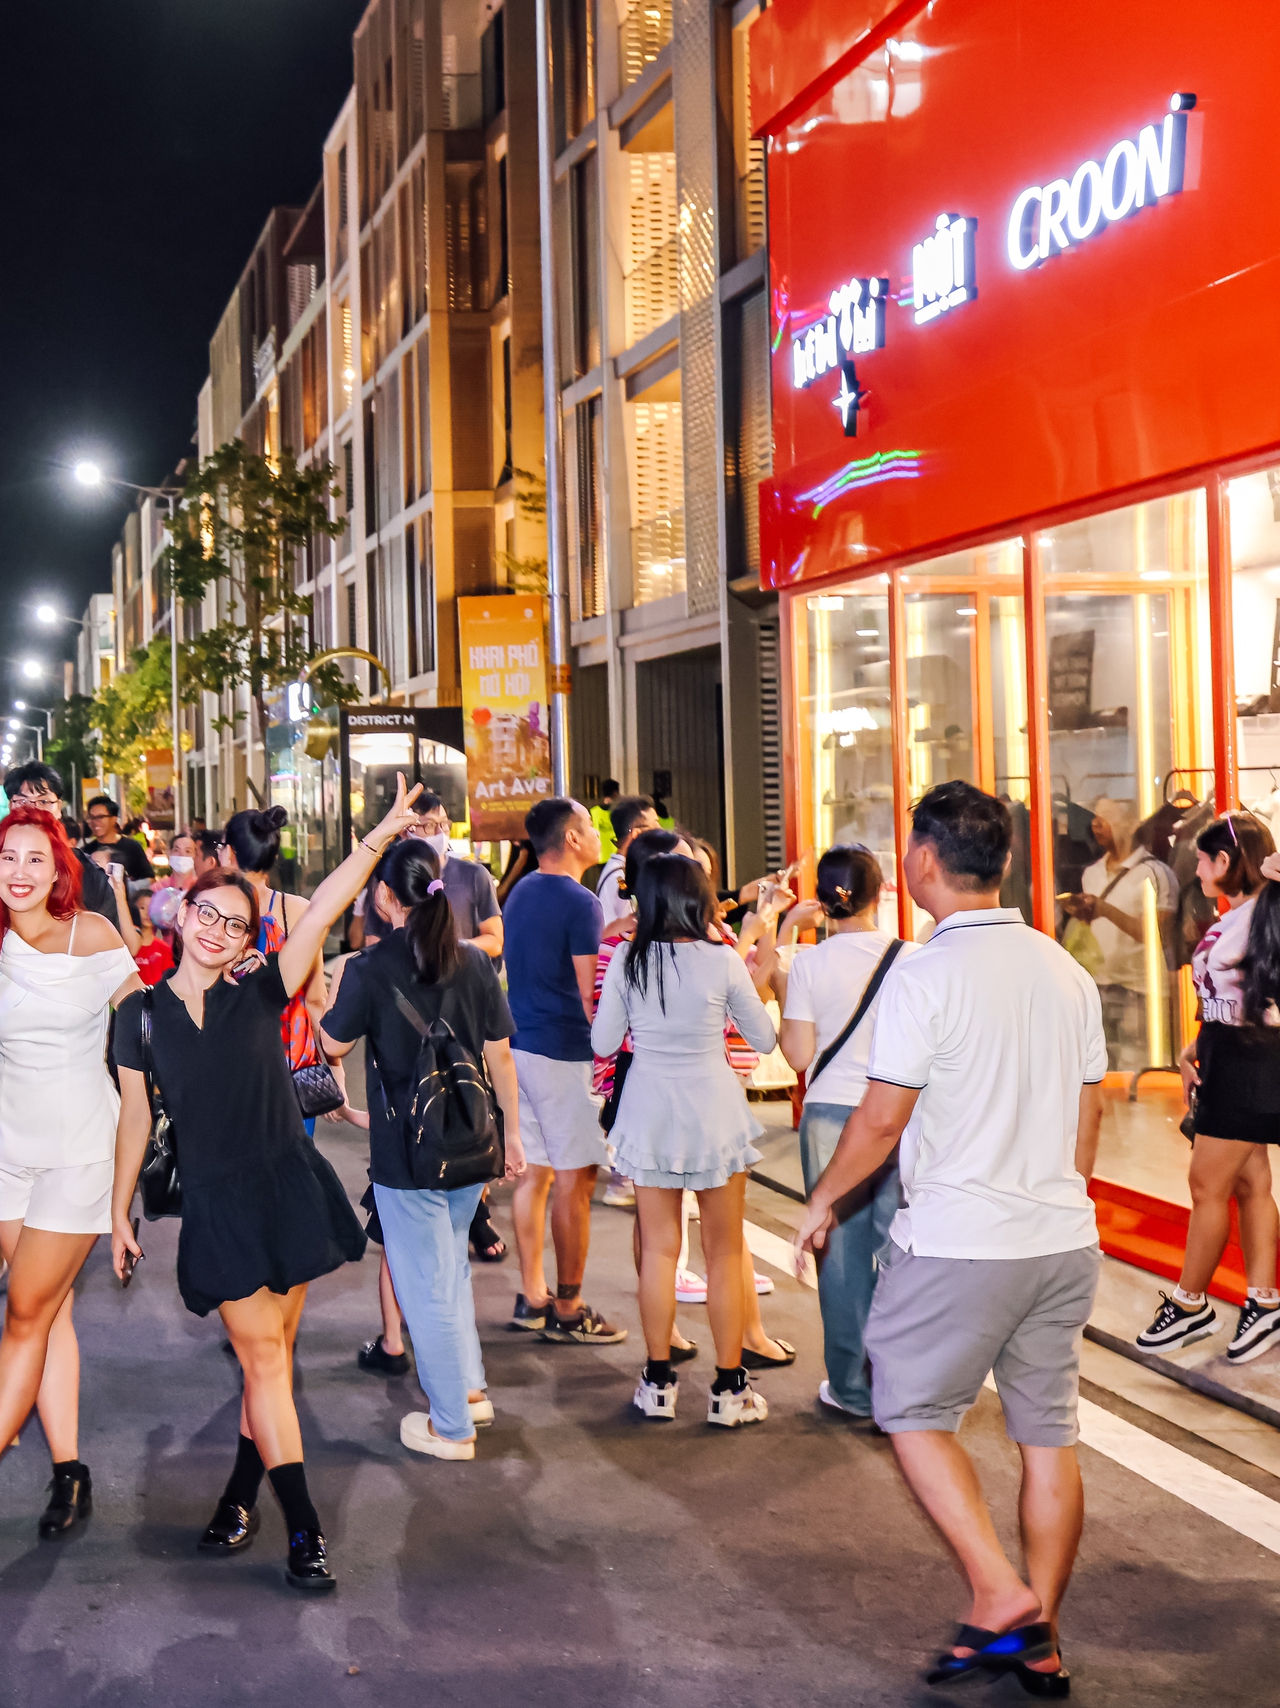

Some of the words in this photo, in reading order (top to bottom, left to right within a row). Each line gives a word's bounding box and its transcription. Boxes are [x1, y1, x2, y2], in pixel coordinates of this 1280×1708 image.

[348, 715, 401, 726] DISTRICT
[403, 714, 415, 725] M
[475, 780, 507, 799] Art
[510, 777, 547, 796] Ave
